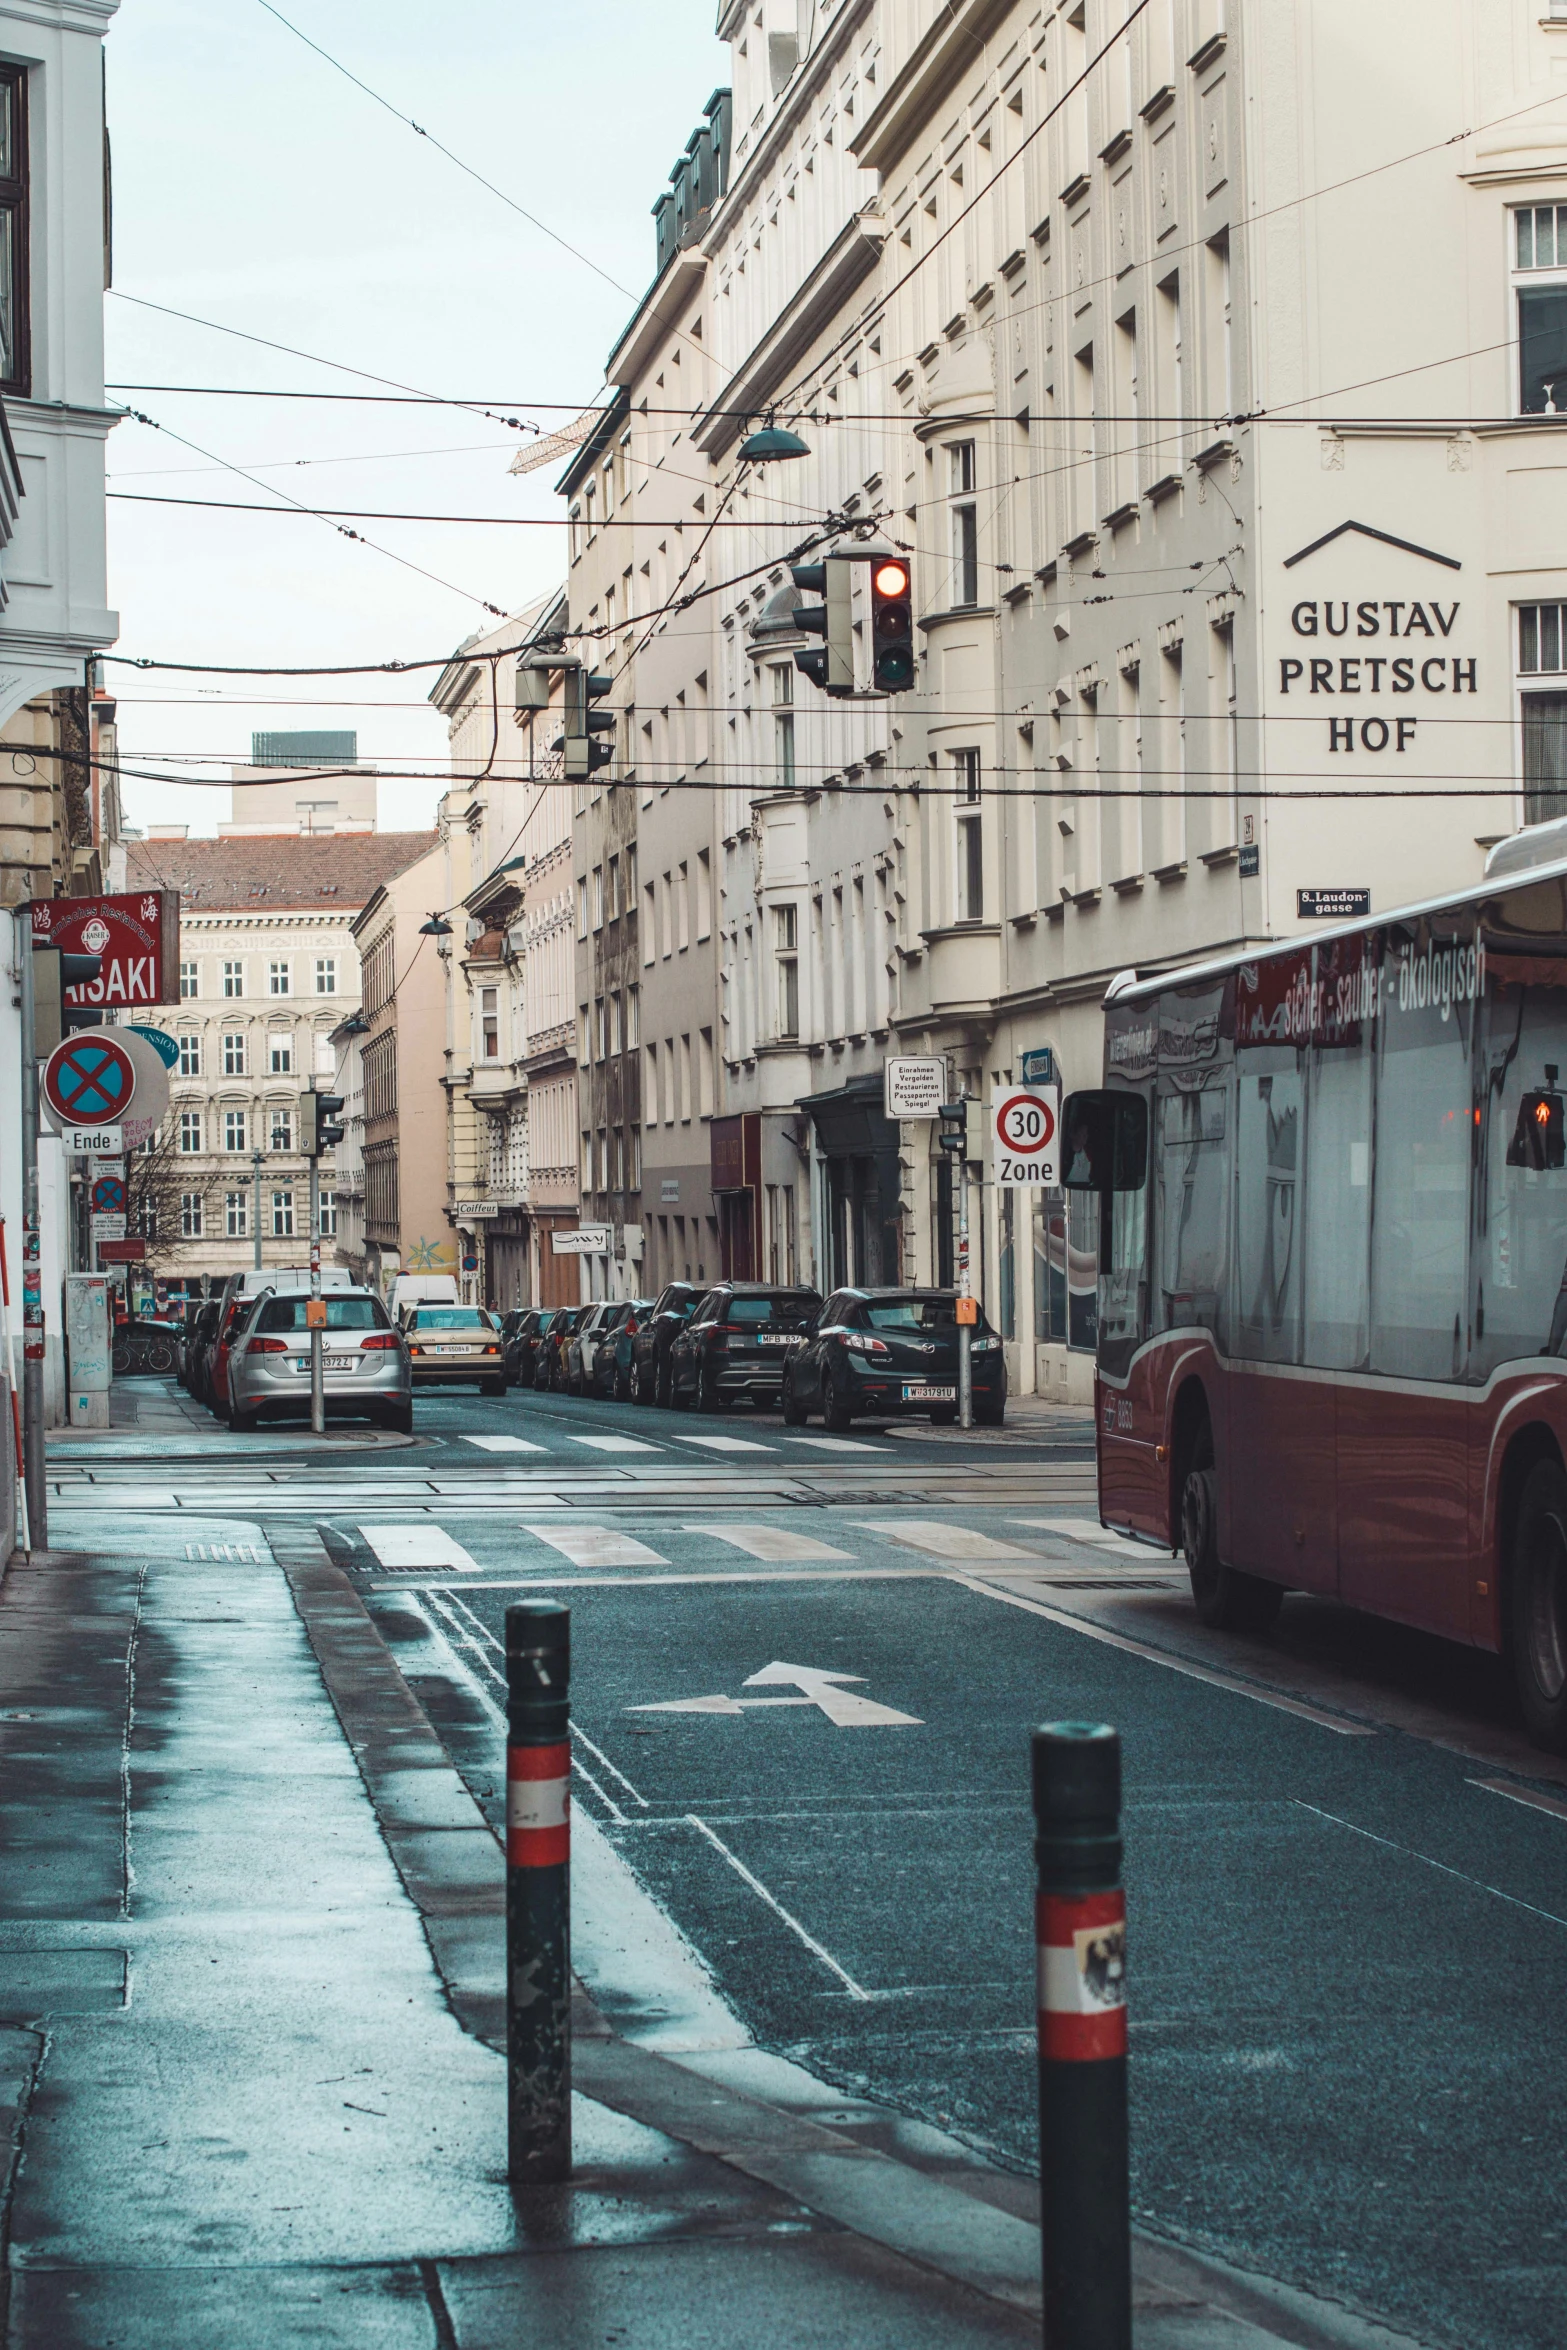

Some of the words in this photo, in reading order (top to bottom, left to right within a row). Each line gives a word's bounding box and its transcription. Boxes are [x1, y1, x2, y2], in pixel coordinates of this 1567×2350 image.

[1291, 601, 1461, 637] GUSTAV
[1279, 657, 1478, 694] PRETSCH
[1328, 716, 1417, 752] HOF
[1315, 891, 1367, 902] Laudon-
[140, 895, 158, 922] 海
[1315, 904, 1353, 915] gasse
[50, 905, 97, 944] anisches
[100, 903, 155, 950] Restaurant
[86, 931, 106, 940] KAISER
[1285, 972, 1324, 1037] sicher
[1336, 955, 1385, 1025] sauber
[1399, 926, 1486, 1023] ökologisch
[898, 1066, 935, 1074] Einrahmen
[899, 1074, 934, 1083] Vergolden
[894, 1083, 939, 1091] Restaurieren
[894, 1091, 940, 1100] Passepartout
[904, 1100, 930, 1108] Spiegel
[1011, 1110, 1040, 1138] 30
[73, 1132, 111, 1149] Ende
[1000, 1158, 1053, 1181] Zone
[460, 1203, 497, 1213] Coiffeur
[554, 1232, 604, 1245] Envy
[762, 1335, 781, 1343] MFB
